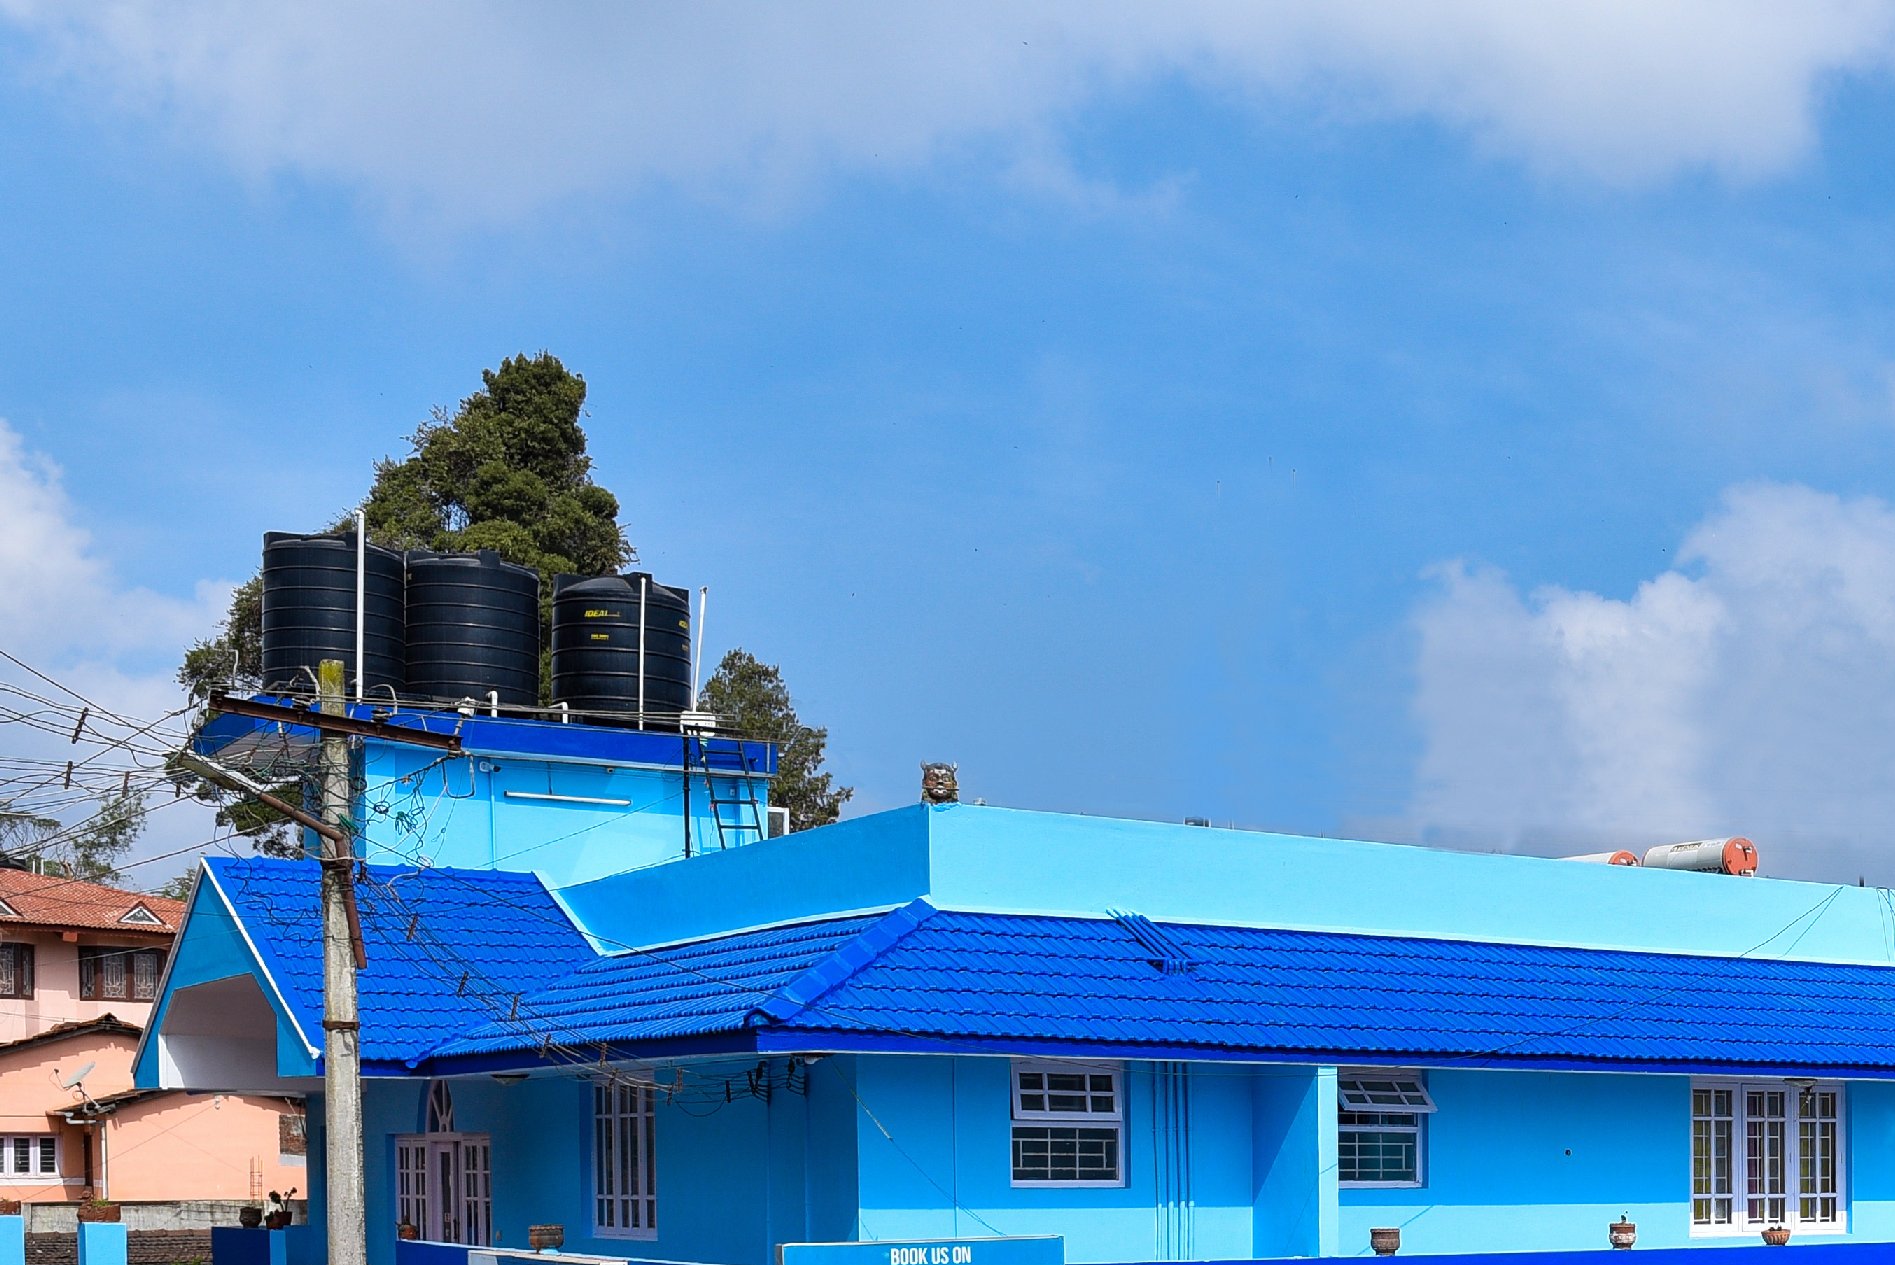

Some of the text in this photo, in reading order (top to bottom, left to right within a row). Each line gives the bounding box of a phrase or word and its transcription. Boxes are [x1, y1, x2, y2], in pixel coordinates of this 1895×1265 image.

[890, 1246, 972, 1265] BOOK US ON
